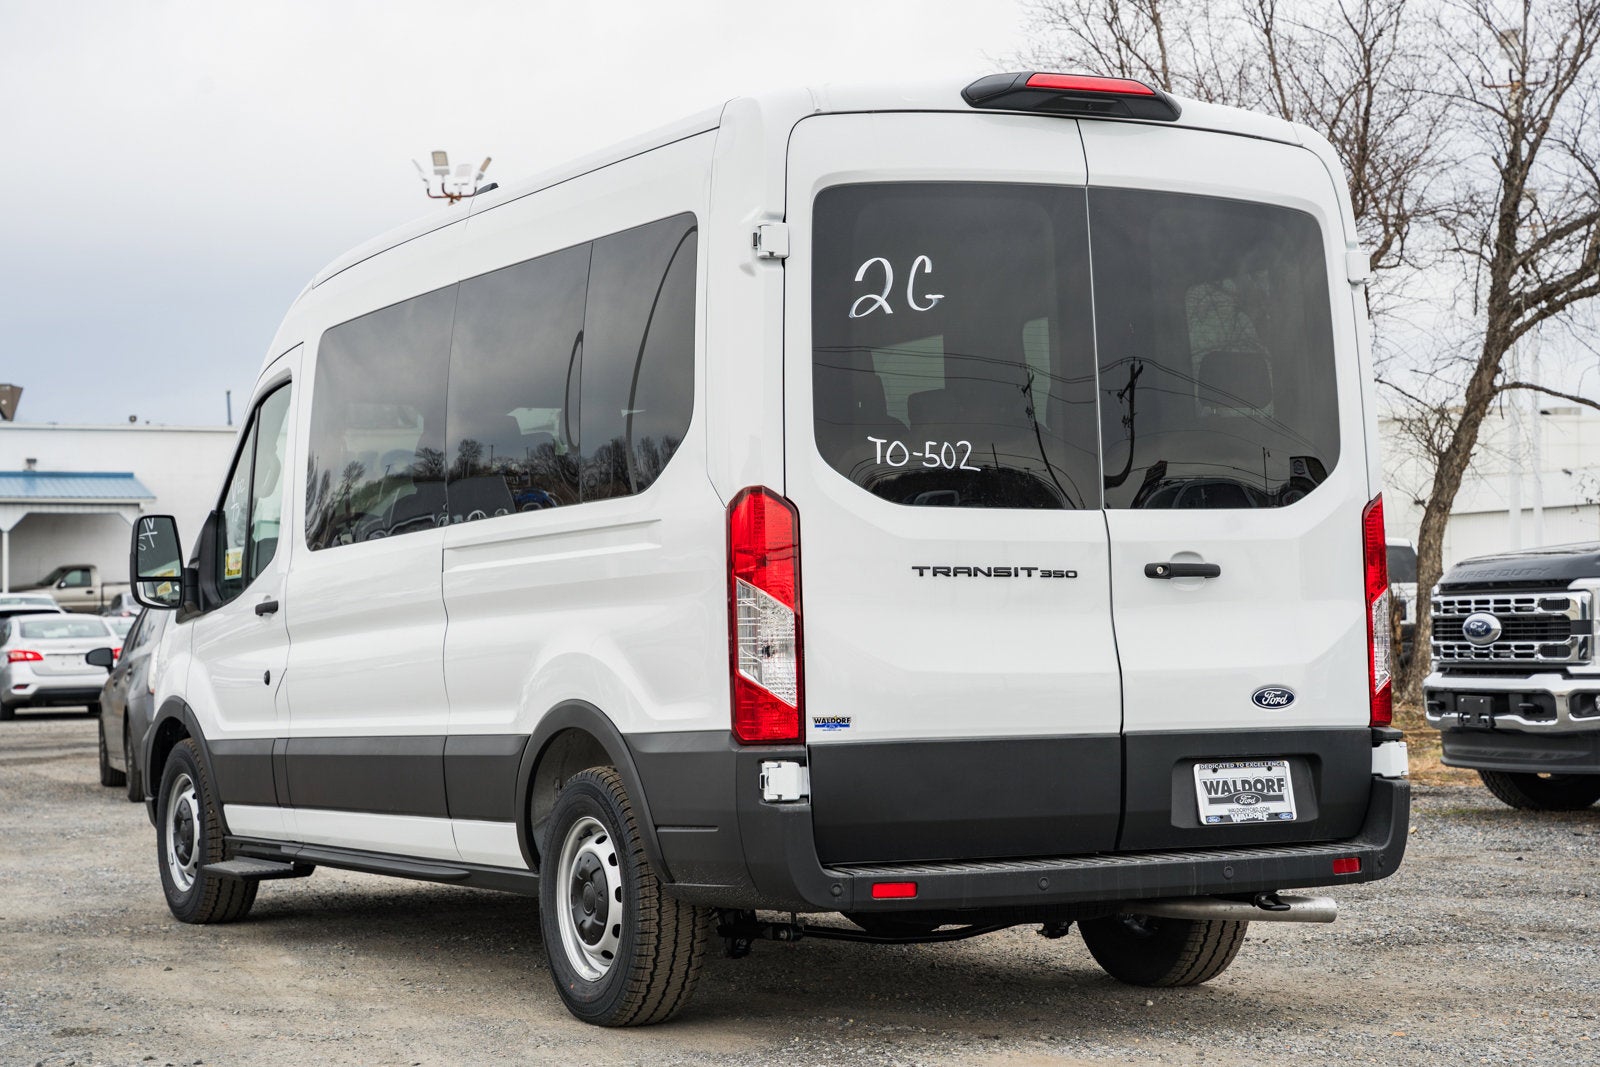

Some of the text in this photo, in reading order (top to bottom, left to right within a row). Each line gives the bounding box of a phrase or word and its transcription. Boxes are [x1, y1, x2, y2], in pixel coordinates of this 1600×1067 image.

[867, 435, 981, 472] TO-502
[1261, 690, 1289, 705] Ford
[1202, 778, 1285, 795] WALDORF
[1239, 795, 1256, 804] Ford
